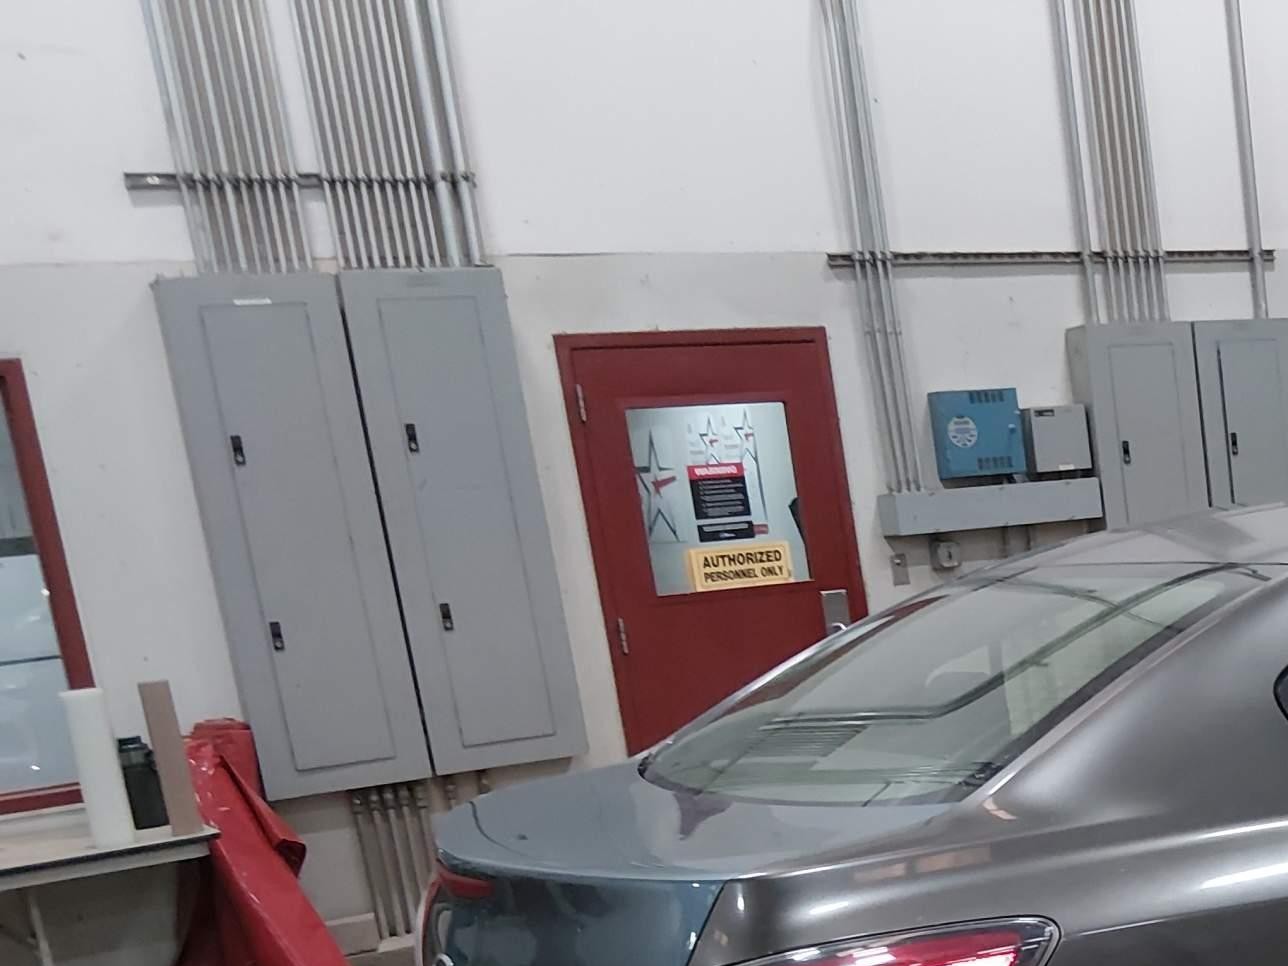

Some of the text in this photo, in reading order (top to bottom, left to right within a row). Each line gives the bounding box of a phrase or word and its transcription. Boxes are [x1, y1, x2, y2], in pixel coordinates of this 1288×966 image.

[703, 549, 782, 569] AUTHORIZED
[703, 565, 784, 583] PERSONNEL ONLY
